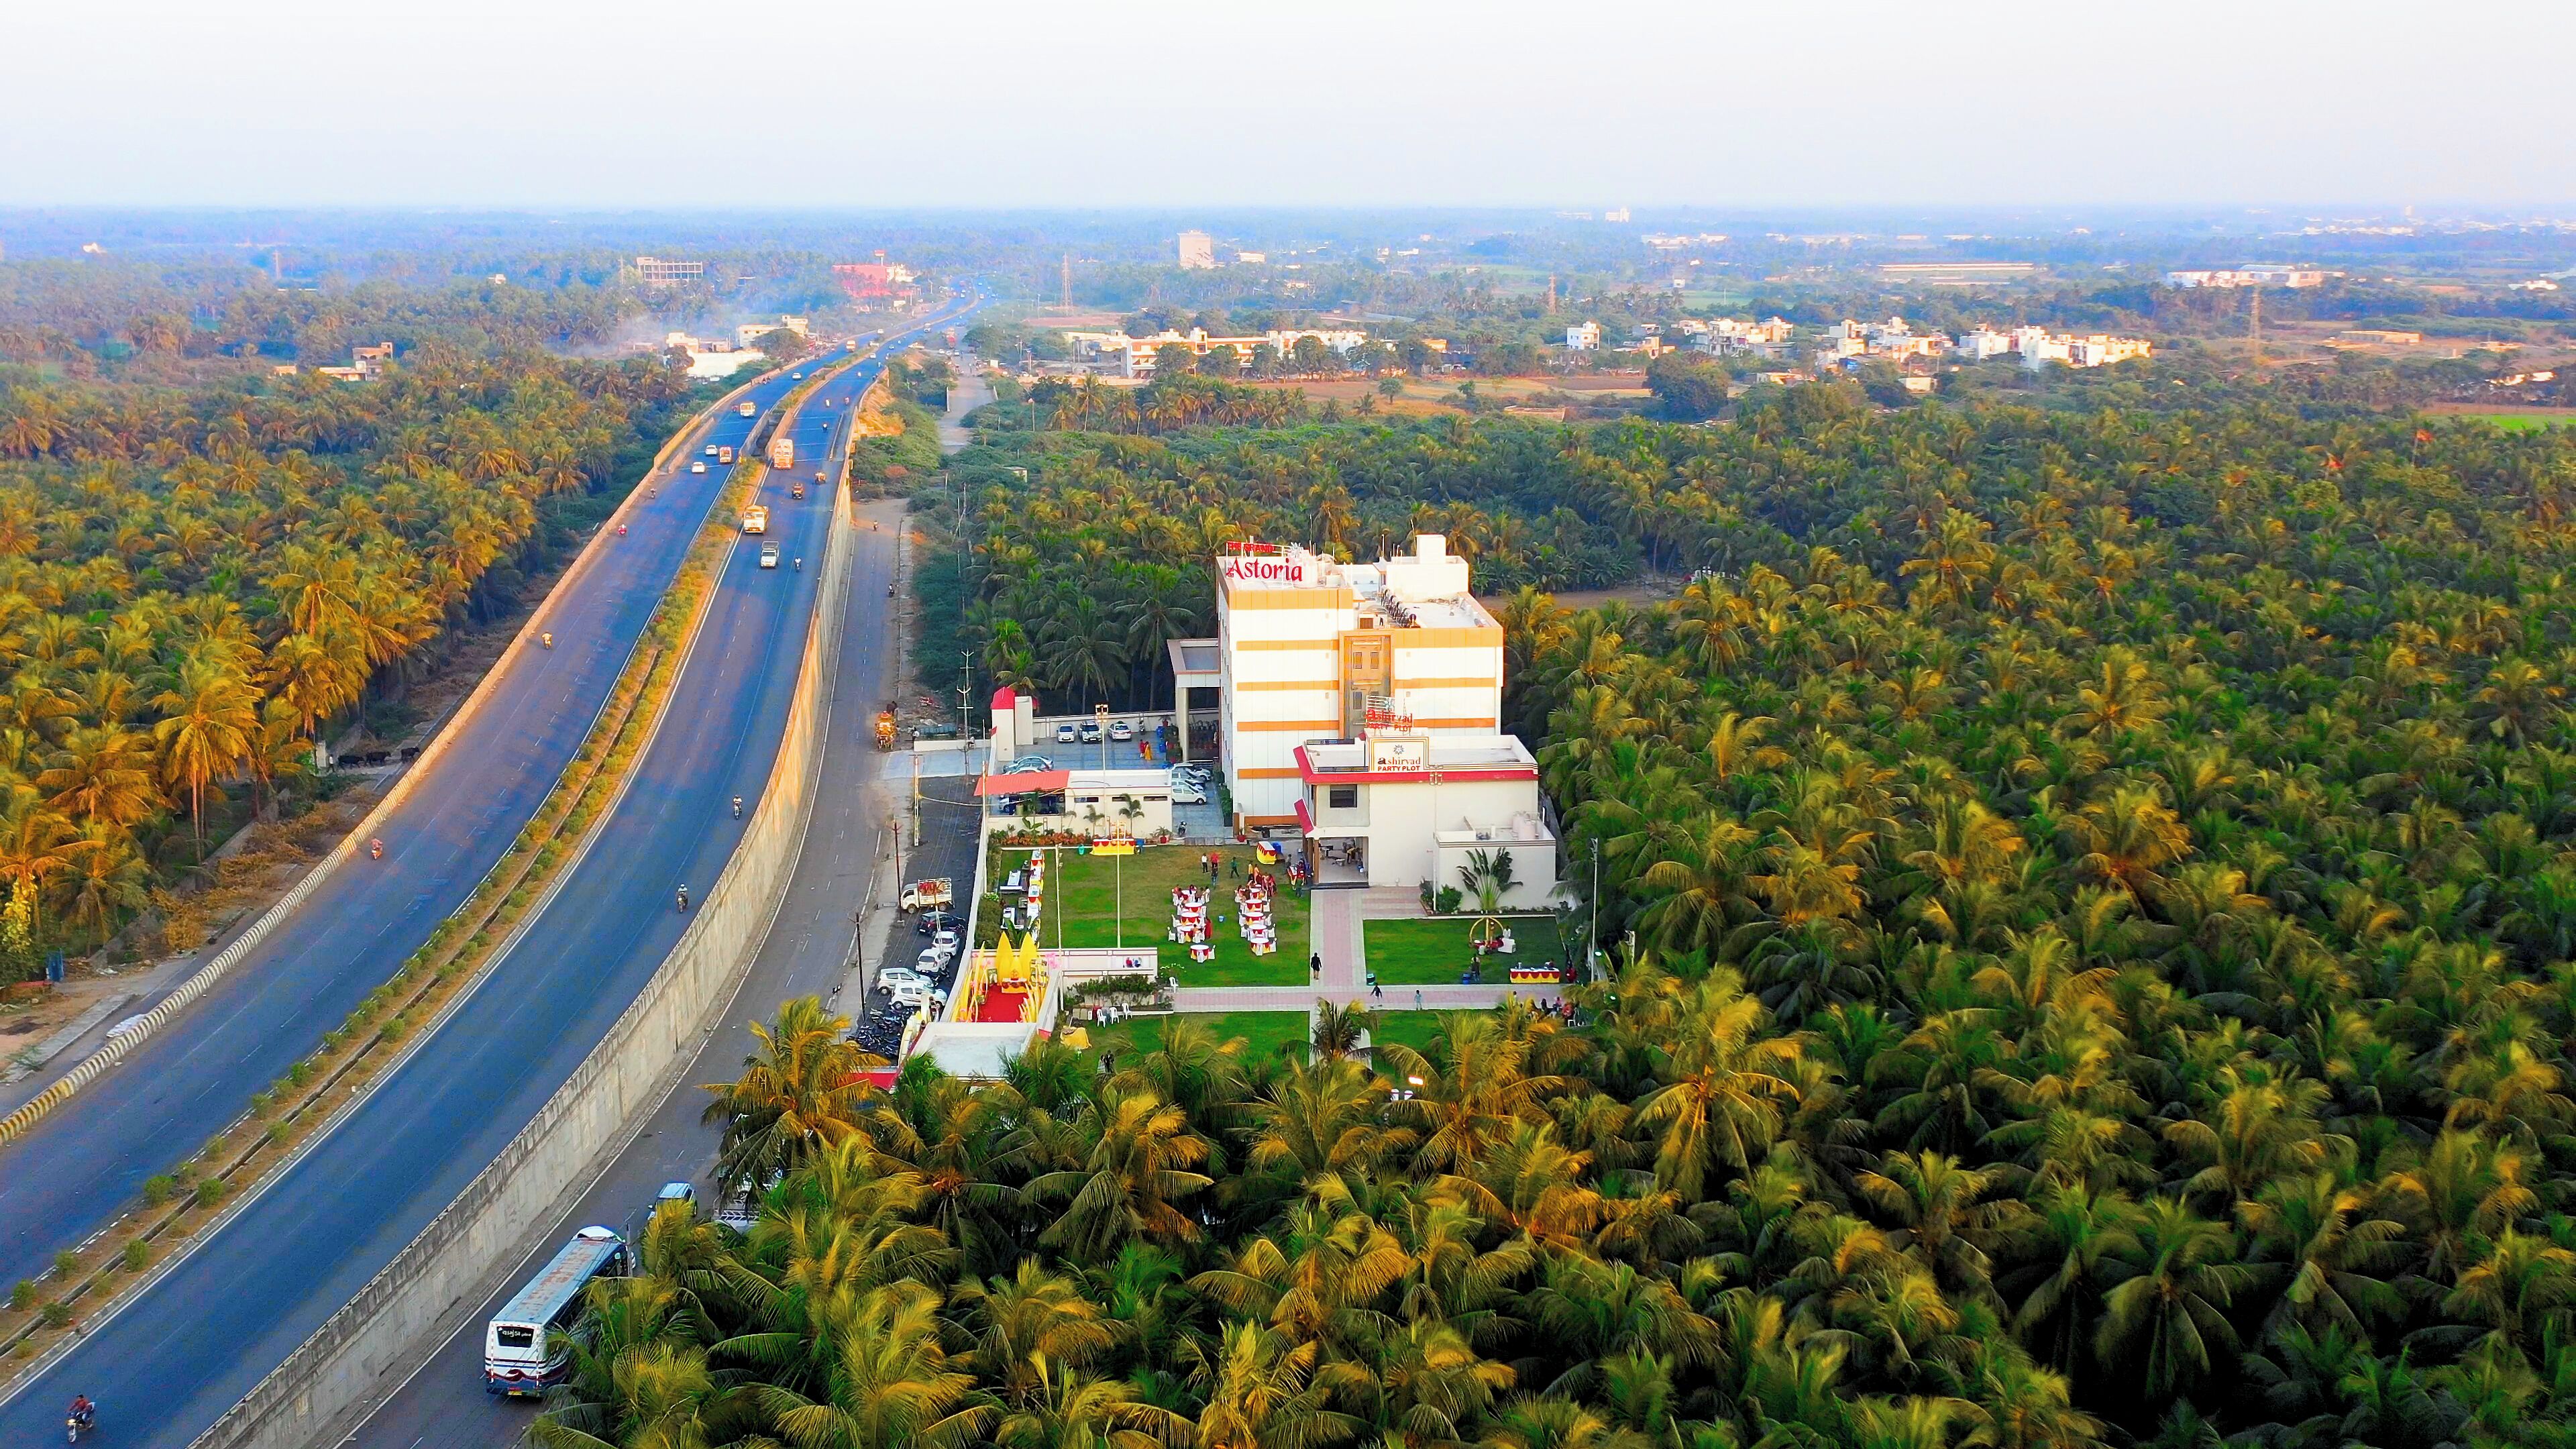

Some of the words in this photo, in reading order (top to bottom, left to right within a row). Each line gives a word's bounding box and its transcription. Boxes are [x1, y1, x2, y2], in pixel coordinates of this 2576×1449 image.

[1244, 543, 1275, 553] GRAND
[1226, 557, 1303, 582] Astoria
[1378, 757, 1421, 765] ashirvad
